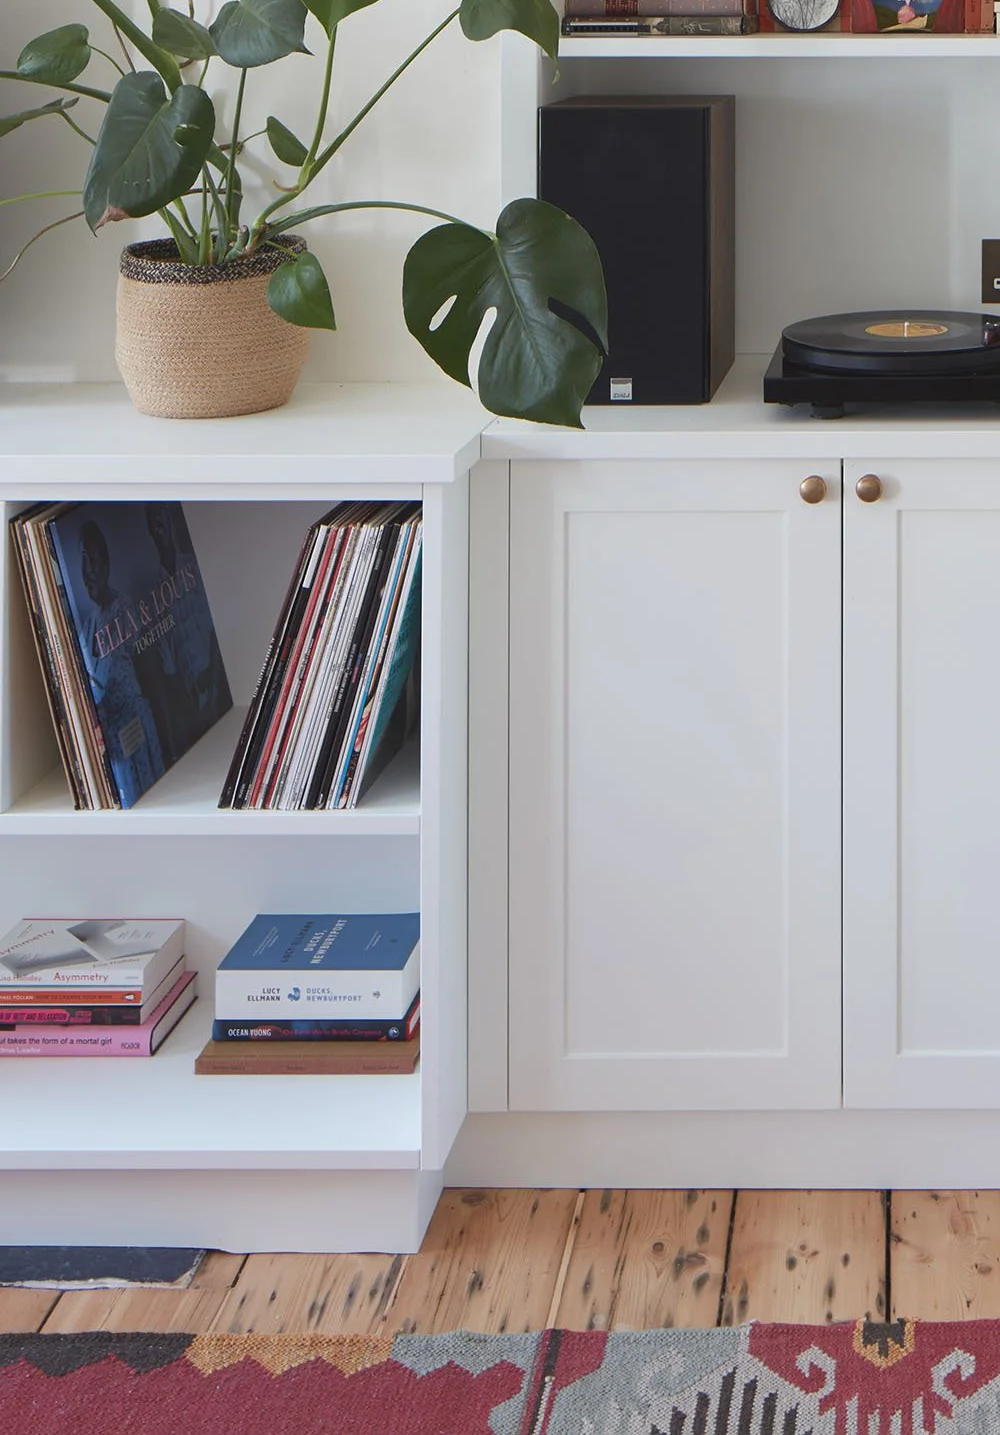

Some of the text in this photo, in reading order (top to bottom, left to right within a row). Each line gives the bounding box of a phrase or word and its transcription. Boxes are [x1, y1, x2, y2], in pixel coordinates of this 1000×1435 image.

[95, 563, 196, 660] ELLA & LOUIS
[134, 614, 176, 654] TOGETHER
[53, 972, 108, 983] Asymmetry
[228, 1028, 272, 1037] OCEAN VUONG
[100, 1038, 112, 1046] girl
